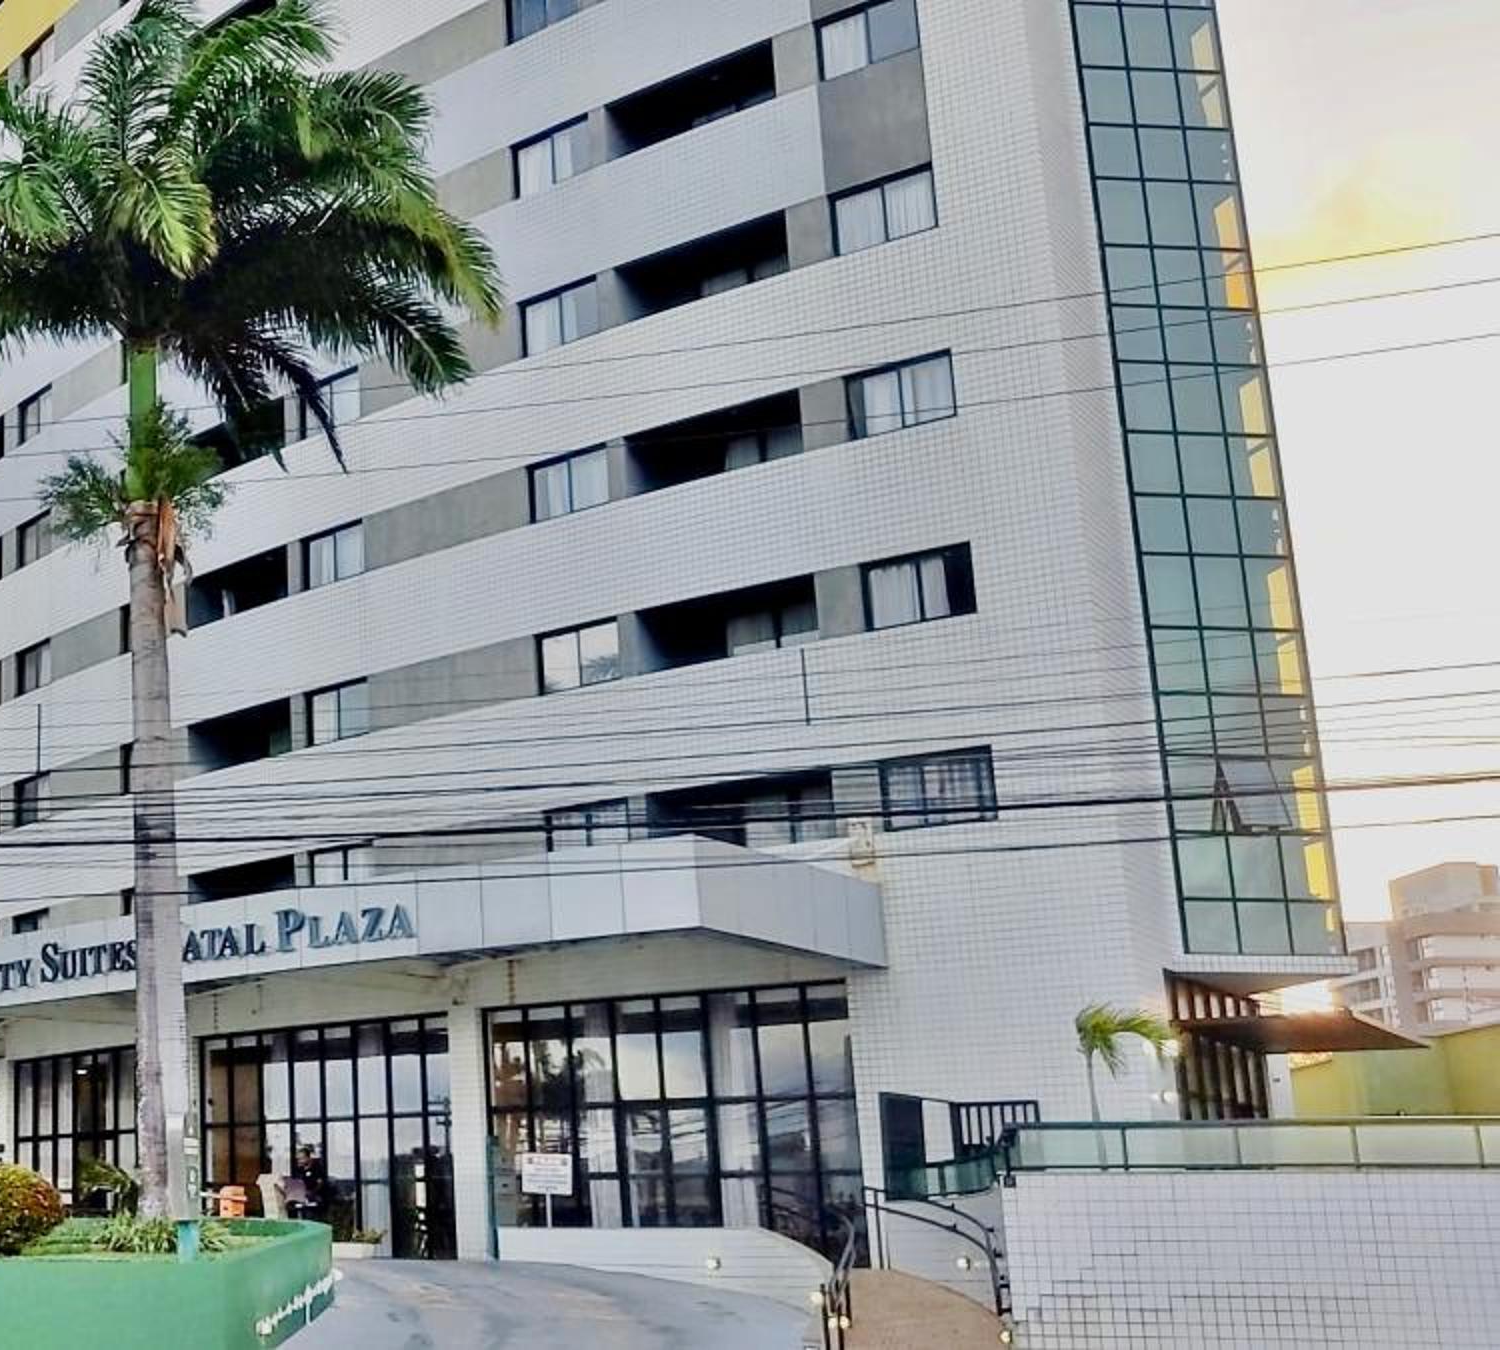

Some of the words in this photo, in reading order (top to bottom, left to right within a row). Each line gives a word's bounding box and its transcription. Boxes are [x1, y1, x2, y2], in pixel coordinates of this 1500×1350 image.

[40, 940, 138, 983] SUITES
[182, 922, 266, 963] ATAL
[275, 903, 418, 954] PLAZA
